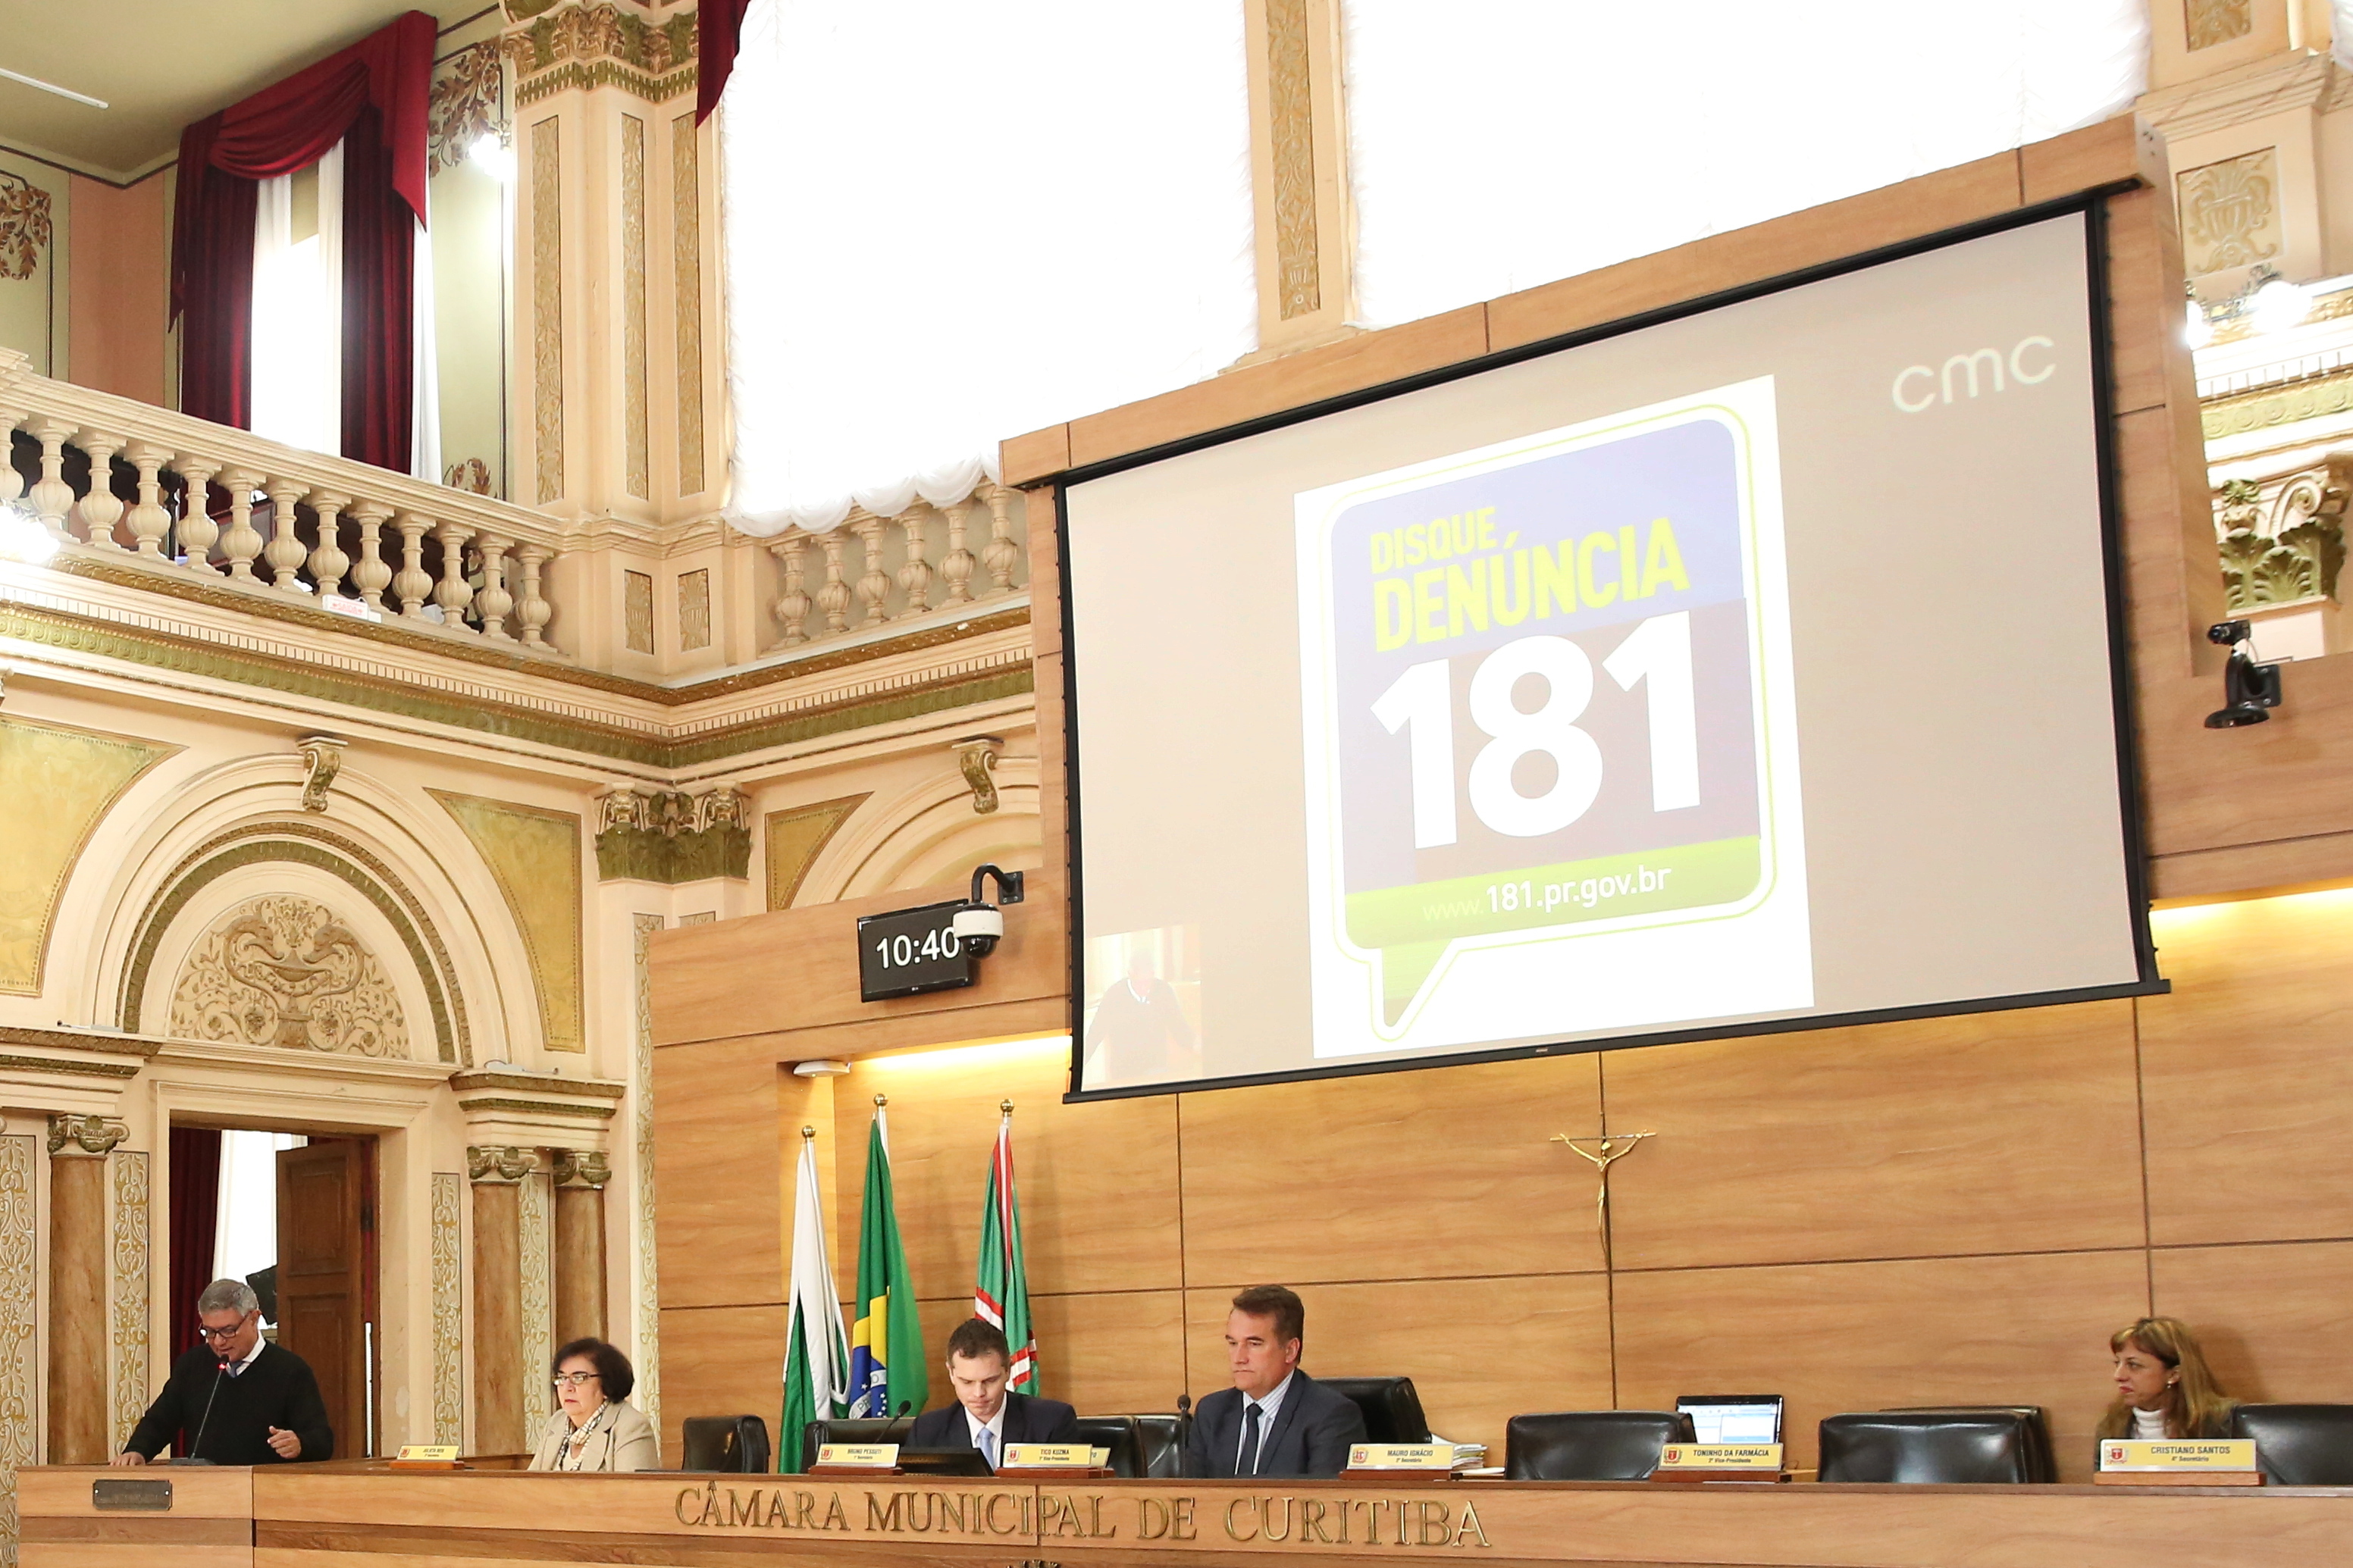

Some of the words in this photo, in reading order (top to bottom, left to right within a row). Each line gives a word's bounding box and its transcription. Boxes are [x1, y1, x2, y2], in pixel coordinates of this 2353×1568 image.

[1891, 334, 2057, 413] cmc
[1369, 505, 1498, 574] DISQUE
[1373, 516, 1691, 653] DENÚNCIA
[1370, 609, 1701, 850] 181
[876, 926, 960, 969] 10:40
[1734, 1448, 1769, 1457] FARMÁCIA
[2151, 1446, 2195, 1454] CRISTIANO
[2197, 1446, 2230, 1454] SANTOS
[674, 1480, 851, 1531] CÂMARA
[863, 1491, 1117, 1539] MUNICIPAL
[1137, 1497, 1198, 1540] DE
[1223, 1496, 1492, 1548] CURITIBA
